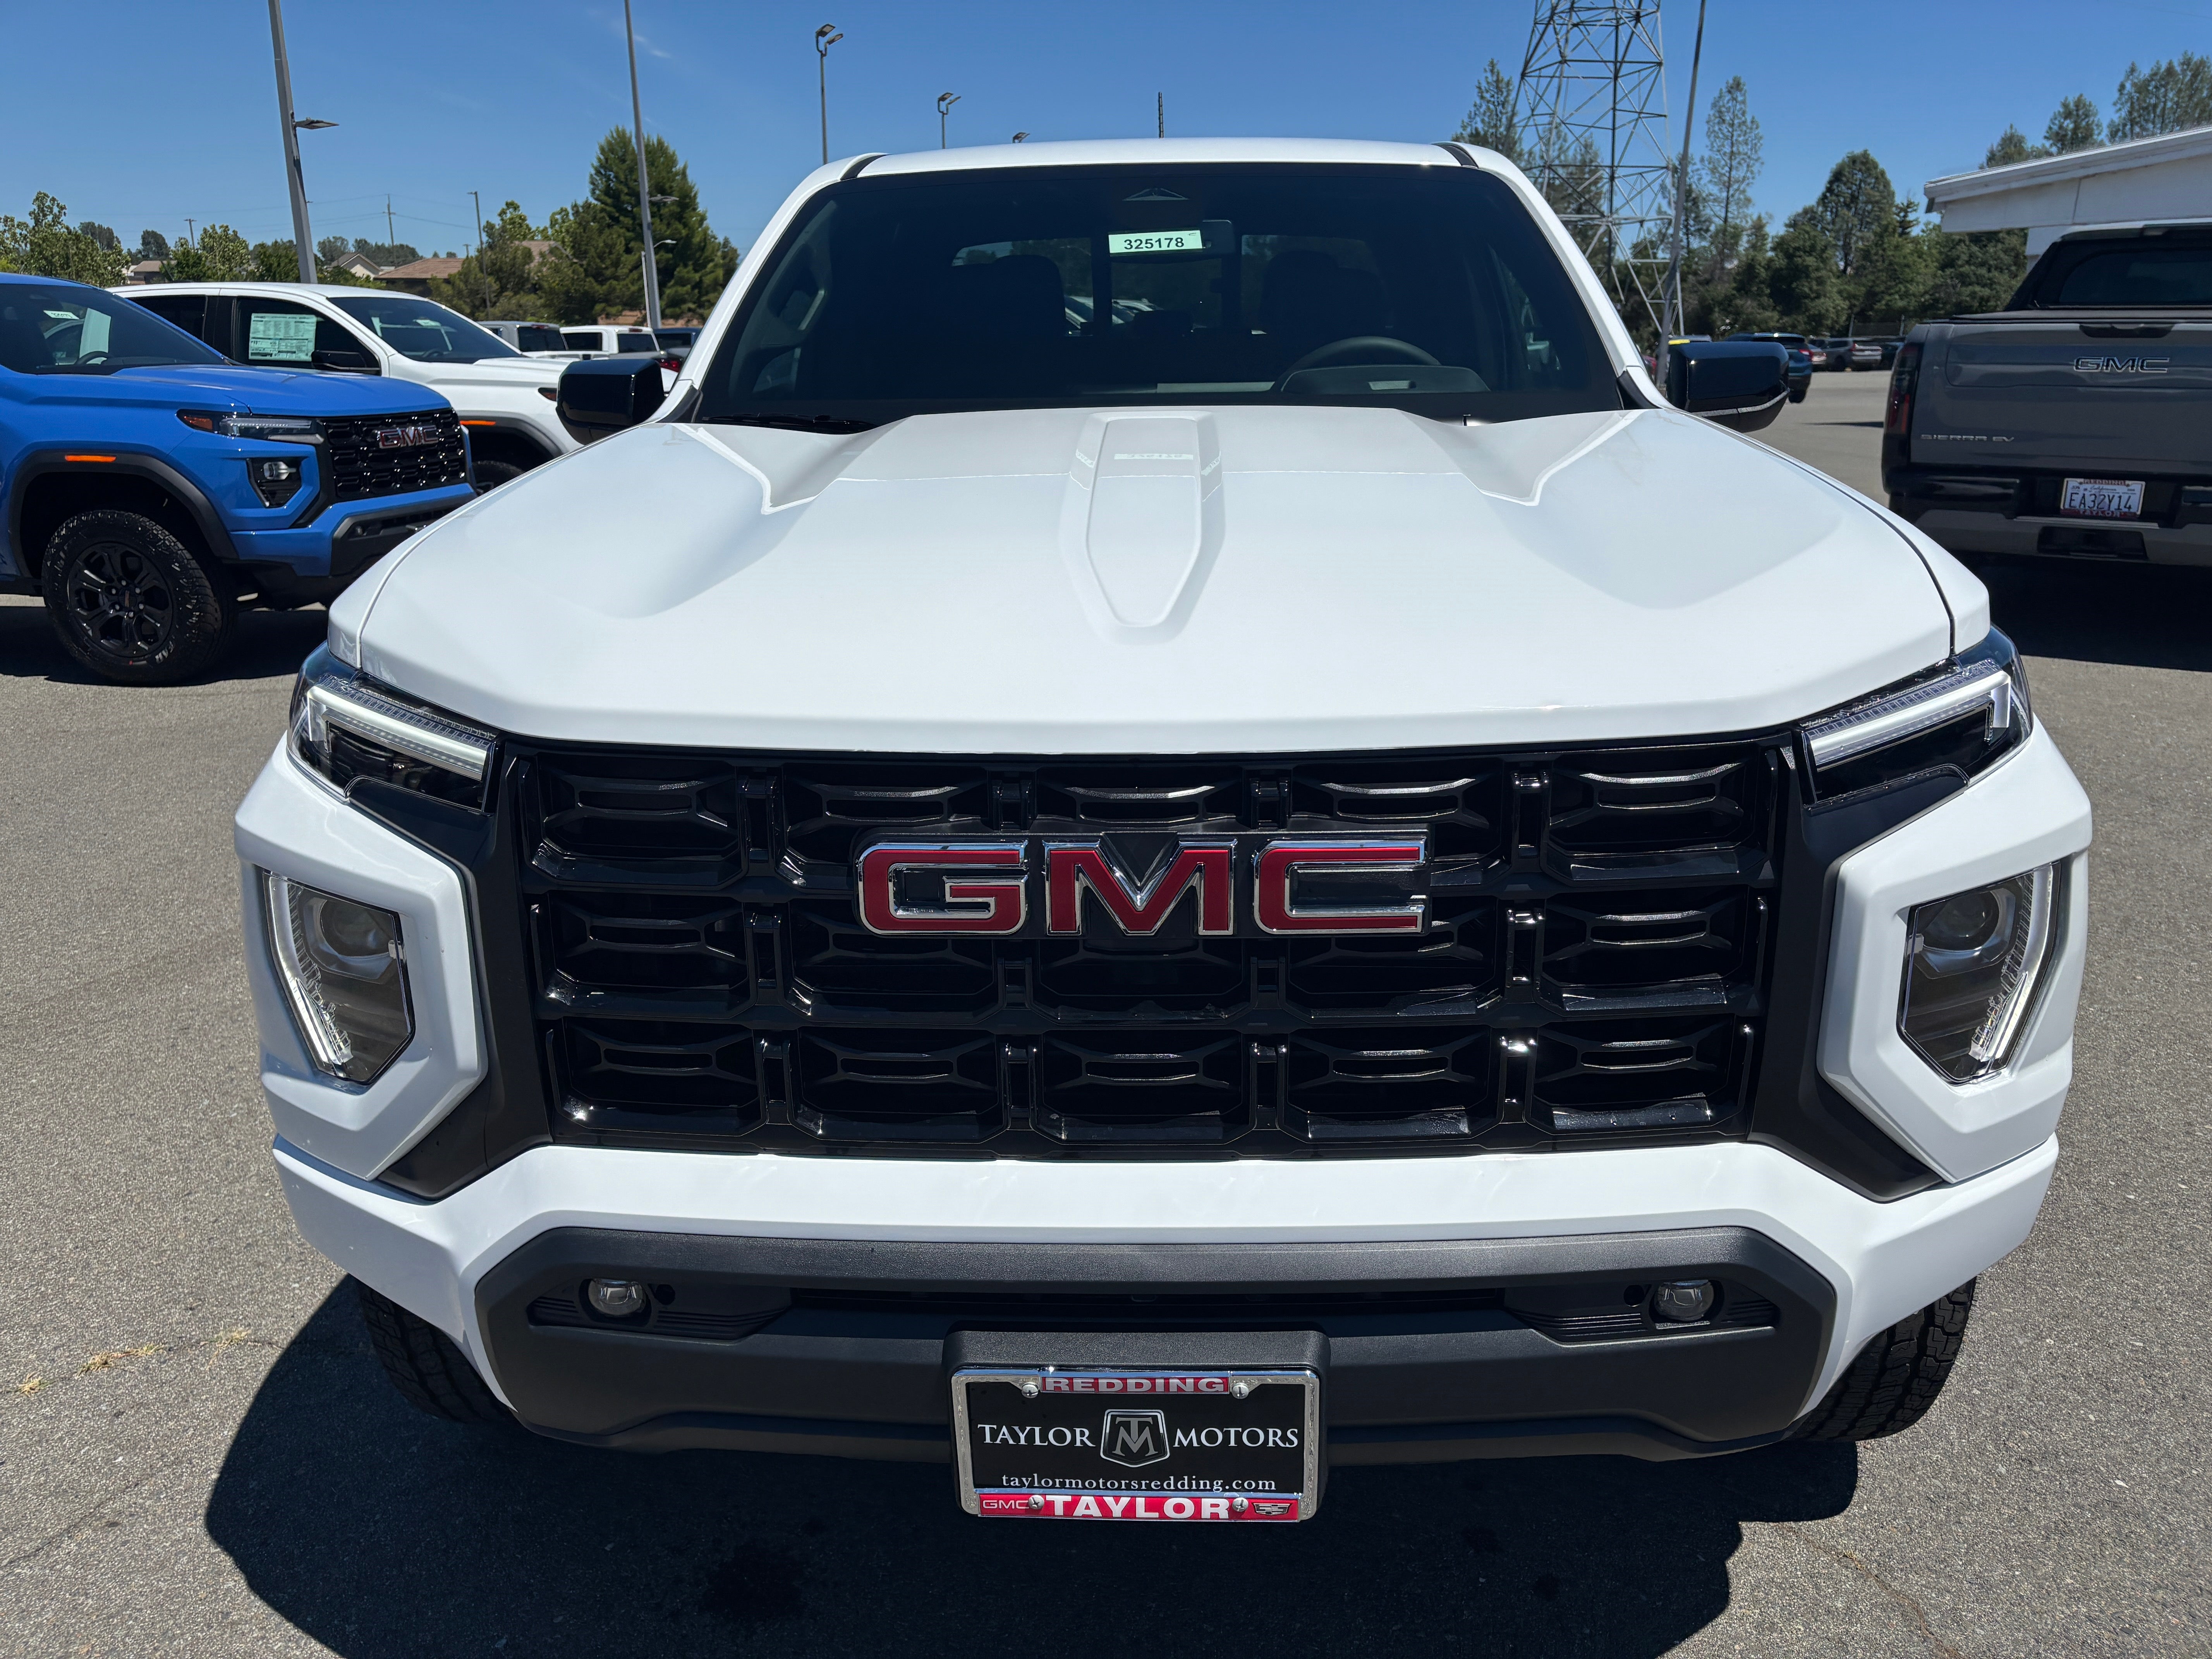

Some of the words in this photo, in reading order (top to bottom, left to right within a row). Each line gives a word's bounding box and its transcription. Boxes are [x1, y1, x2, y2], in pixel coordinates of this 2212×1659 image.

[1124, 237, 1184, 249] 325178
[2074, 356, 2169, 373] GMC
[379, 425, 439, 449] GMC
[2069, 492, 2131, 511] EA32Y14
[857, 835, 1427, 935] GMC
[1045, 1377, 1224, 1392] REDDING
[977, 1424, 1096, 1447] TAYLOR
[1173, 1427, 1298, 1448] MOTORS
[1002, 1473, 1276, 1492] taylormotorsredding.com
[982, 1500, 1029, 1509] GMC
[1046, 1495, 1229, 1519] TAYLOR
